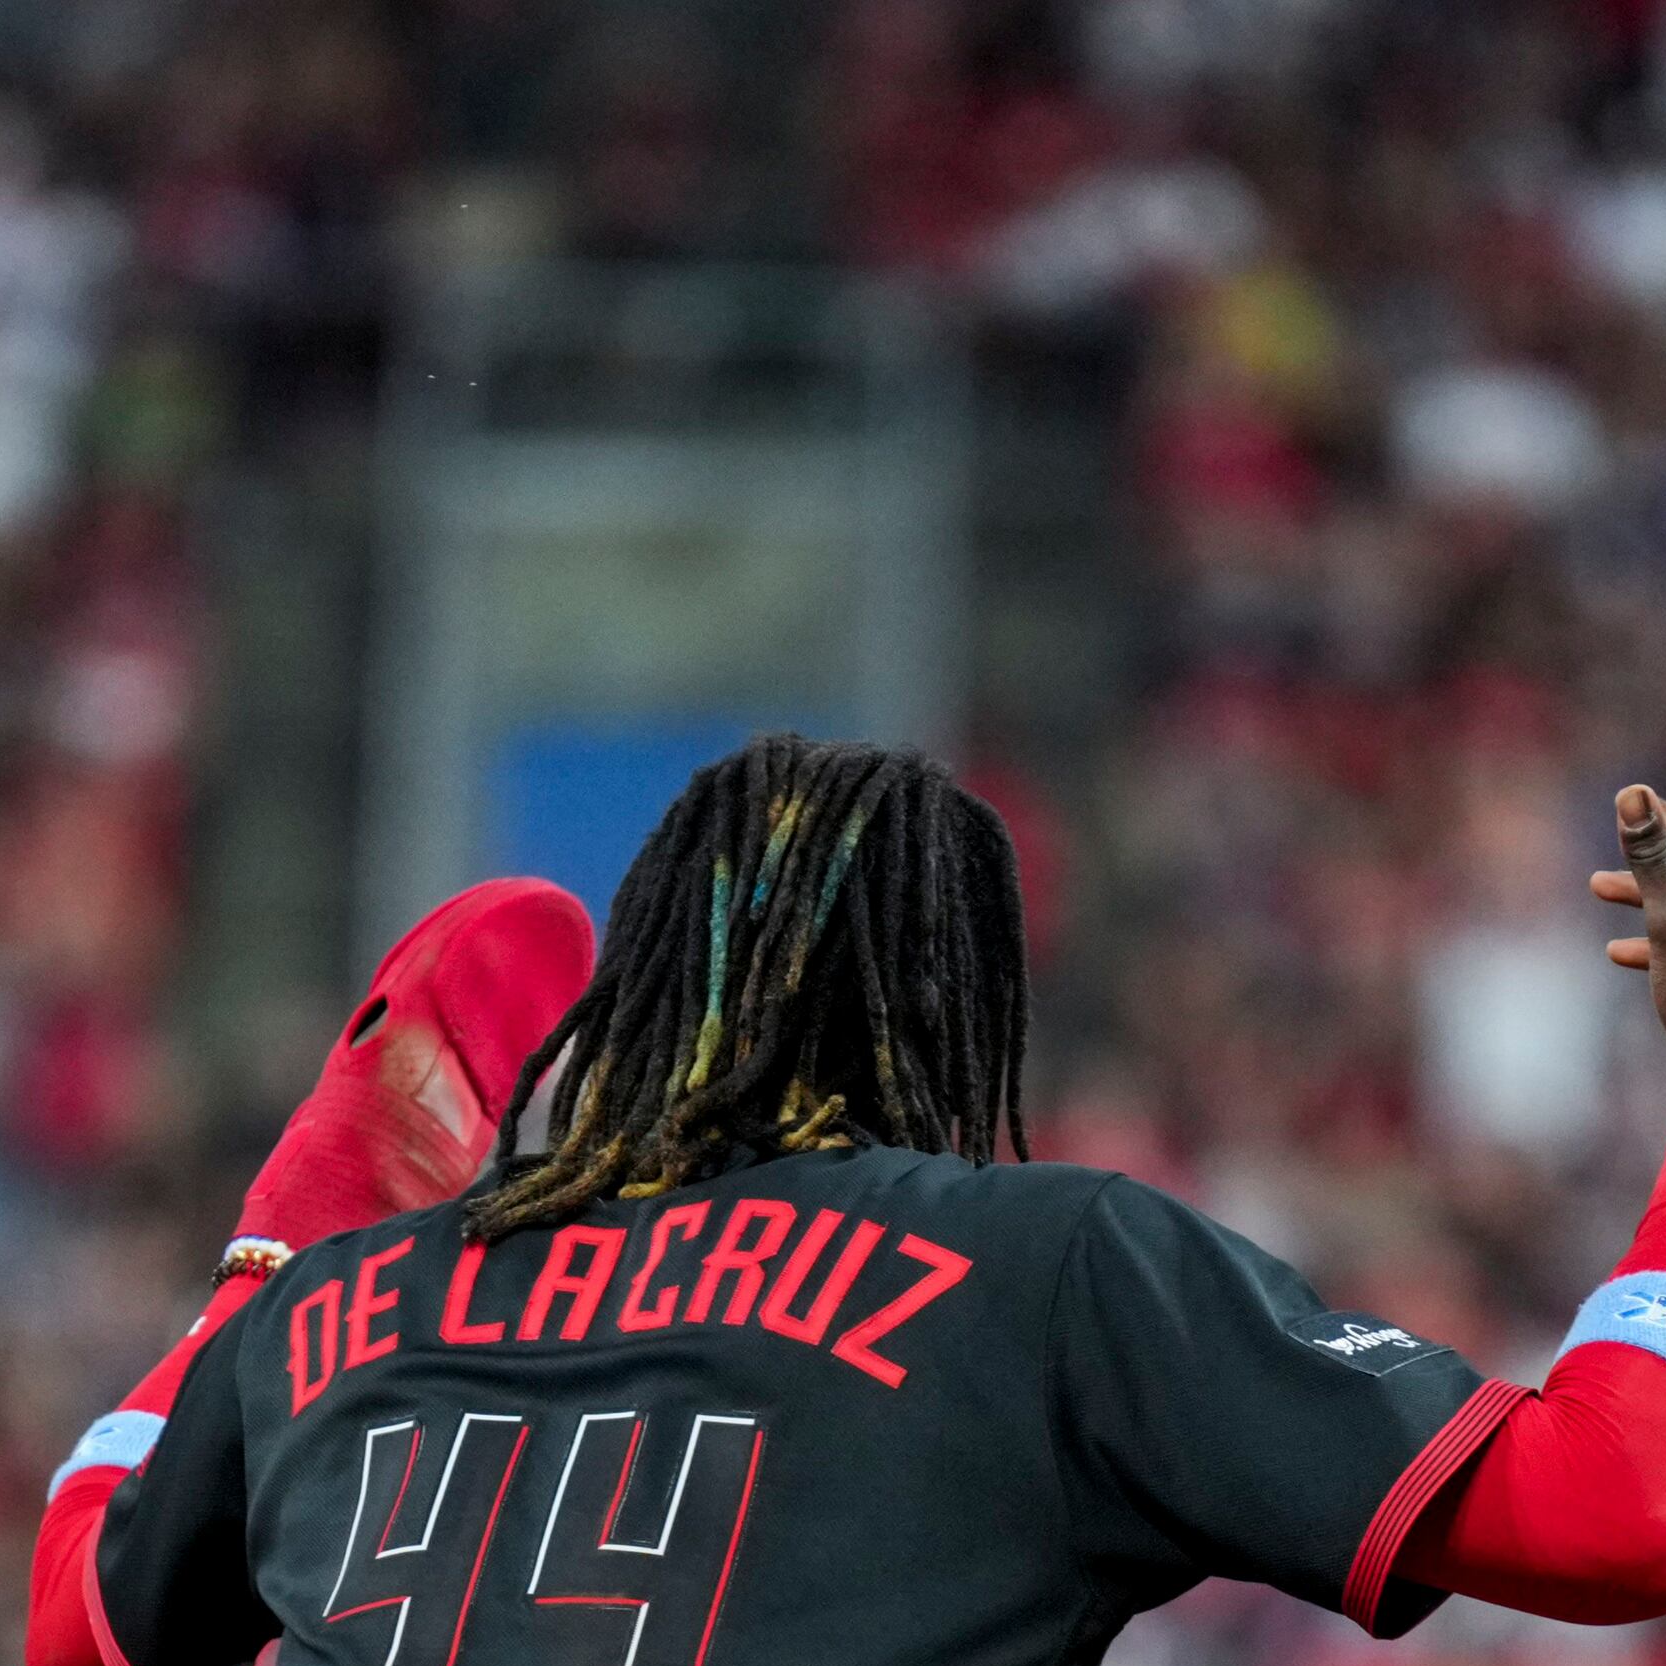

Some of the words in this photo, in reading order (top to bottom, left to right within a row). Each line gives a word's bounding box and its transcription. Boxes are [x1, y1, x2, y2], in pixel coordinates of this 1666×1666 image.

[287, 1237, 415, 1417] DE
[439, 1226, 627, 1344] LA
[617, 1199, 974, 1389] CRUZ
